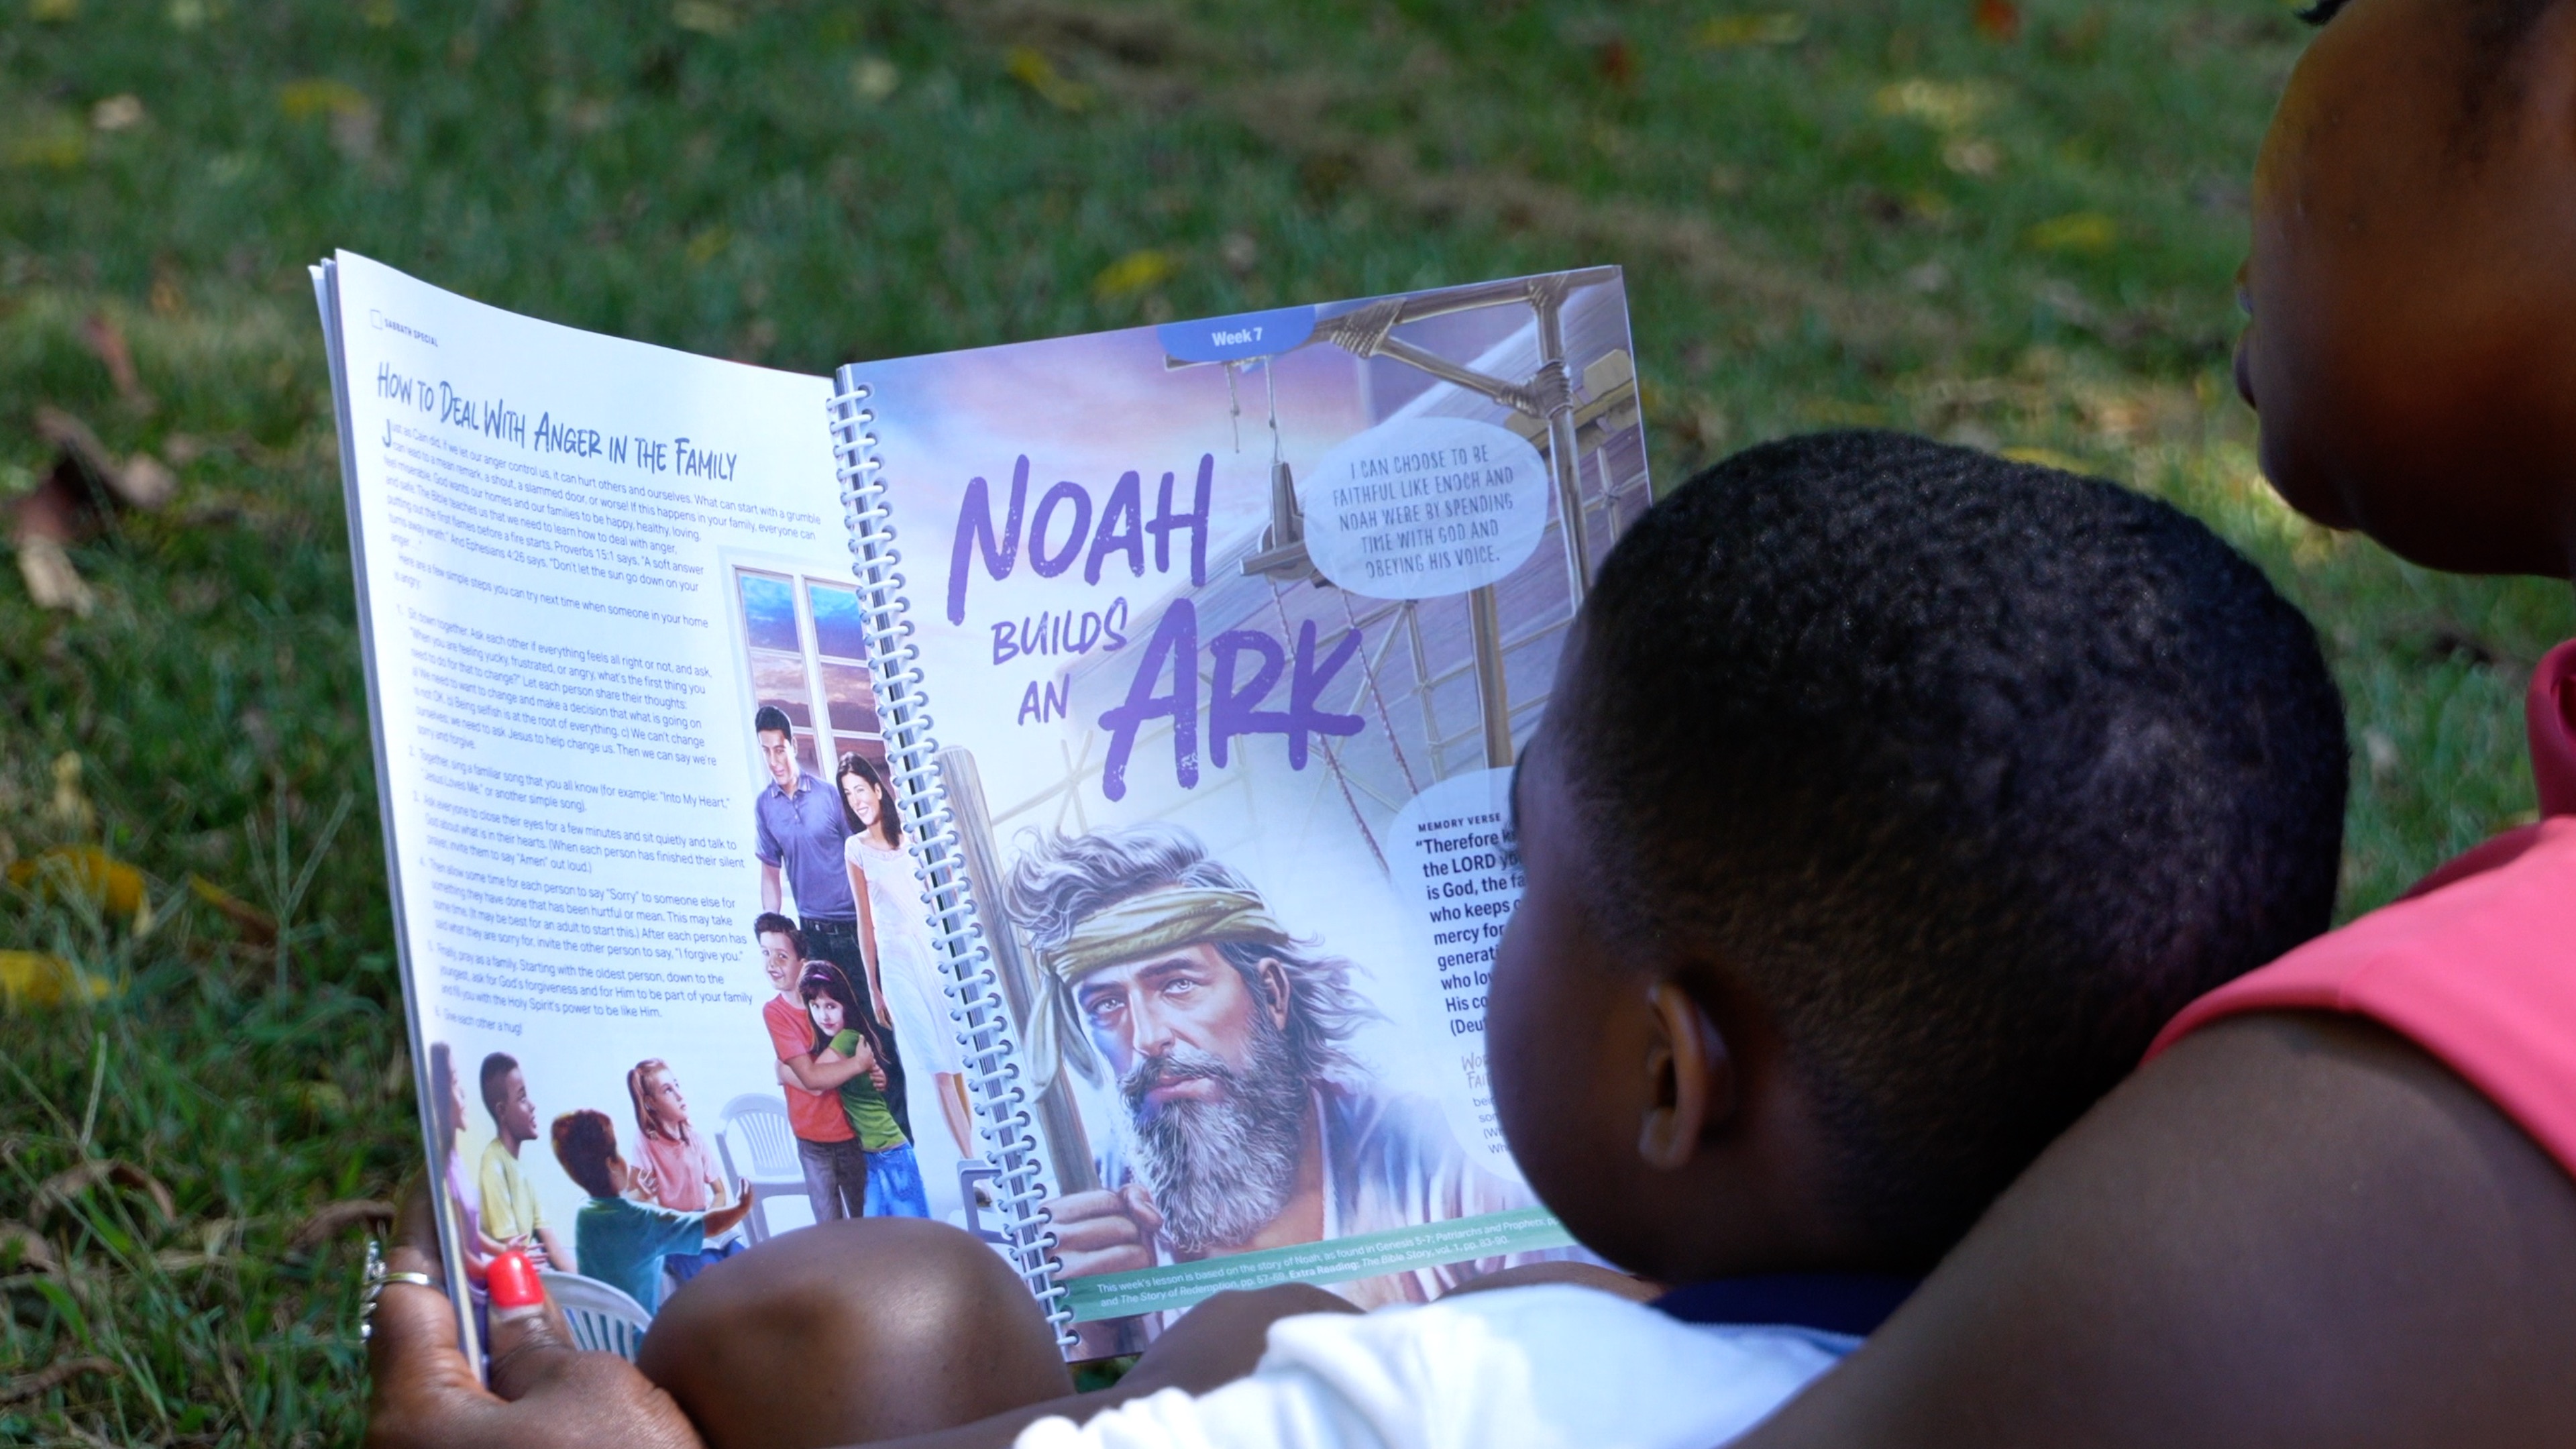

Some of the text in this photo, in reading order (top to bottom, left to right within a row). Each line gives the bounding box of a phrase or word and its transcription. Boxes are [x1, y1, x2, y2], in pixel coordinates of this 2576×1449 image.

[1212, 327, 1263, 347] Week 7
[1351, 444, 1488, 480] I CAN CHOOSE TO BE
[508, 462, 820, 525] control us, it can hurt others and ourselves. What can start with a grumble
[1333, 466, 1514, 506] FAITHFUL LIKE ENOCH AND
[1340, 492, 1513, 531] NOAH WERE BY SPENDING
[947, 453, 1214, 625] NOAH
[1360, 519, 1499, 553] TIME WITH GOD AND
[554, 541, 704, 574] Proverbs 15:1 says, “A soft answer
[1365, 545, 1500, 579] OBEYING HIS VOICE.
[991, 597, 1128, 665] BUILDS
[538, 645, 713, 678] everything feels all right or not, and ask,
[523, 678, 687, 710] Let each person share their thoughts:
[1018, 598, 1364, 801] AN ARK
[508, 729, 716, 765] Jesus to help change us. Then we can say we’re
[545, 780, 561, 790] you
[564, 781, 573, 790] all
[575, 782, 598, 794] know
[660, 792, 681, 804] “Into
[683, 794, 696, 807] My
[699, 796, 729, 808] Heart,”
[1417, 812, 1501, 833] MEMORY VERSE
[549, 839, 745, 867] (When each person has finished their silent
[1415, 833, 1499, 855] “Therefore
[1423, 862, 1449, 877] the
[1452, 853, 1496, 874] LORD
[1427, 885, 1440, 900] is
[1443, 879, 1478, 898] God,
[1481, 877, 1507, 892] the
[1430, 906, 1461, 922] who
[1464, 900, 1510, 918] keeps
[642, 928, 747, 944] After each person has
[1434, 922, 1504, 945] mercy for
[1441, 974, 1471, 990] who
[1446, 996, 1469, 1012] His
[1097, 1284, 1118, 1293] This
[1152, 1275, 1184, 1285] lesson
[1185, 1273, 1194, 1281] is
[1194, 1268, 1224, 1280] based
[1226, 1267, 1238, 1275] on
[1239, 1265, 1256, 1273] the
[1257, 1262, 1281, 1270] story
[1284, 1257, 1293, 1266] of
[1336, 1246, 1364, 1257] found
[1376, 1240, 1413, 1250] Genesis
[1436, 1229, 1483, 1240] Patriarchs
[1485, 1224, 1501, 1233] and
[1101, 1296, 1118, 1307] and
[1121, 1293, 1138, 1304] The
[1140, 1291, 1166, 1302] Story
[1168, 1287, 1178, 1298] of
[1180, 1279, 1239, 1296] Redemption,
[1240, 1278, 1255, 1288] pp.
[1289, 1267, 1315, 1279] Extra
[1317, 1261, 1360, 1275] Reading:
[1361, 1257, 1379, 1267] The
[1382, 1254, 1405, 1264] Bible
[1406, 1249, 1434, 1260] Story,
[1436, 1246, 1450, 1256] vol.
[1454, 1245, 1462, 1254] 1,
[1464, 1243, 1479, 1252] pp.
